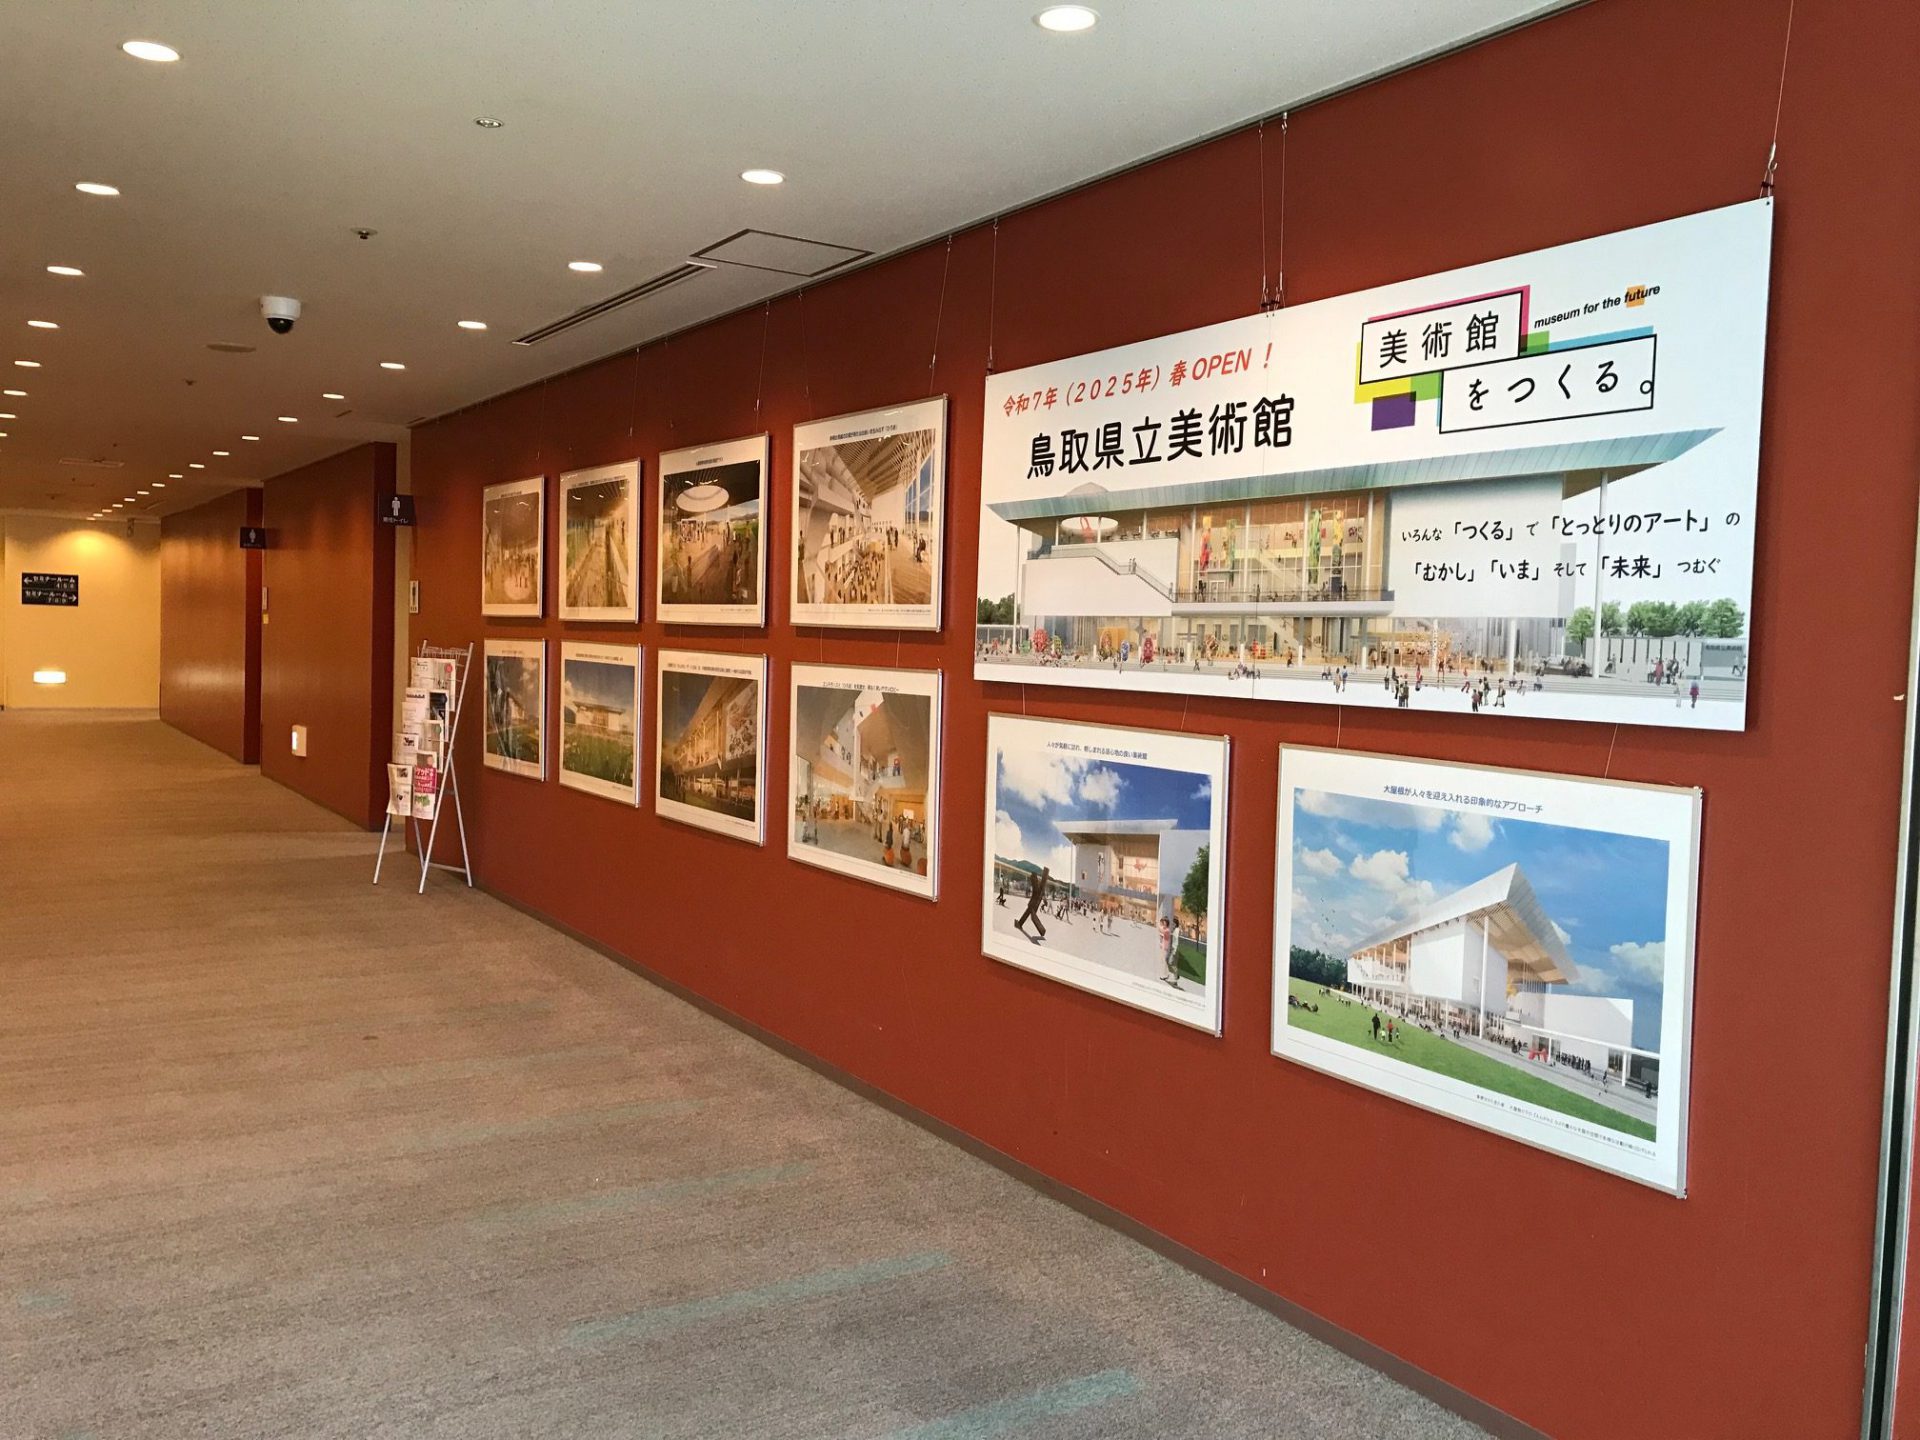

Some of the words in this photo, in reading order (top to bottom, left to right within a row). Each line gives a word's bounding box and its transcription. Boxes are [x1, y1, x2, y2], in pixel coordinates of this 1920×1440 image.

[1534, 308, 1580, 328] museum
[1583, 302, 1600, 315] for
[1602, 296, 1621, 310] the
[1624, 285, 1660, 303] future
[1379, 310, 1499, 368] 美術館
[1468, 360, 1653, 411] をつくる。
[1027, 393, 1294, 480] 鳥取県立美術館
[1383, 784, 1543, 814] 大屋根が人々を迎え入れる印象的なアプローチ
